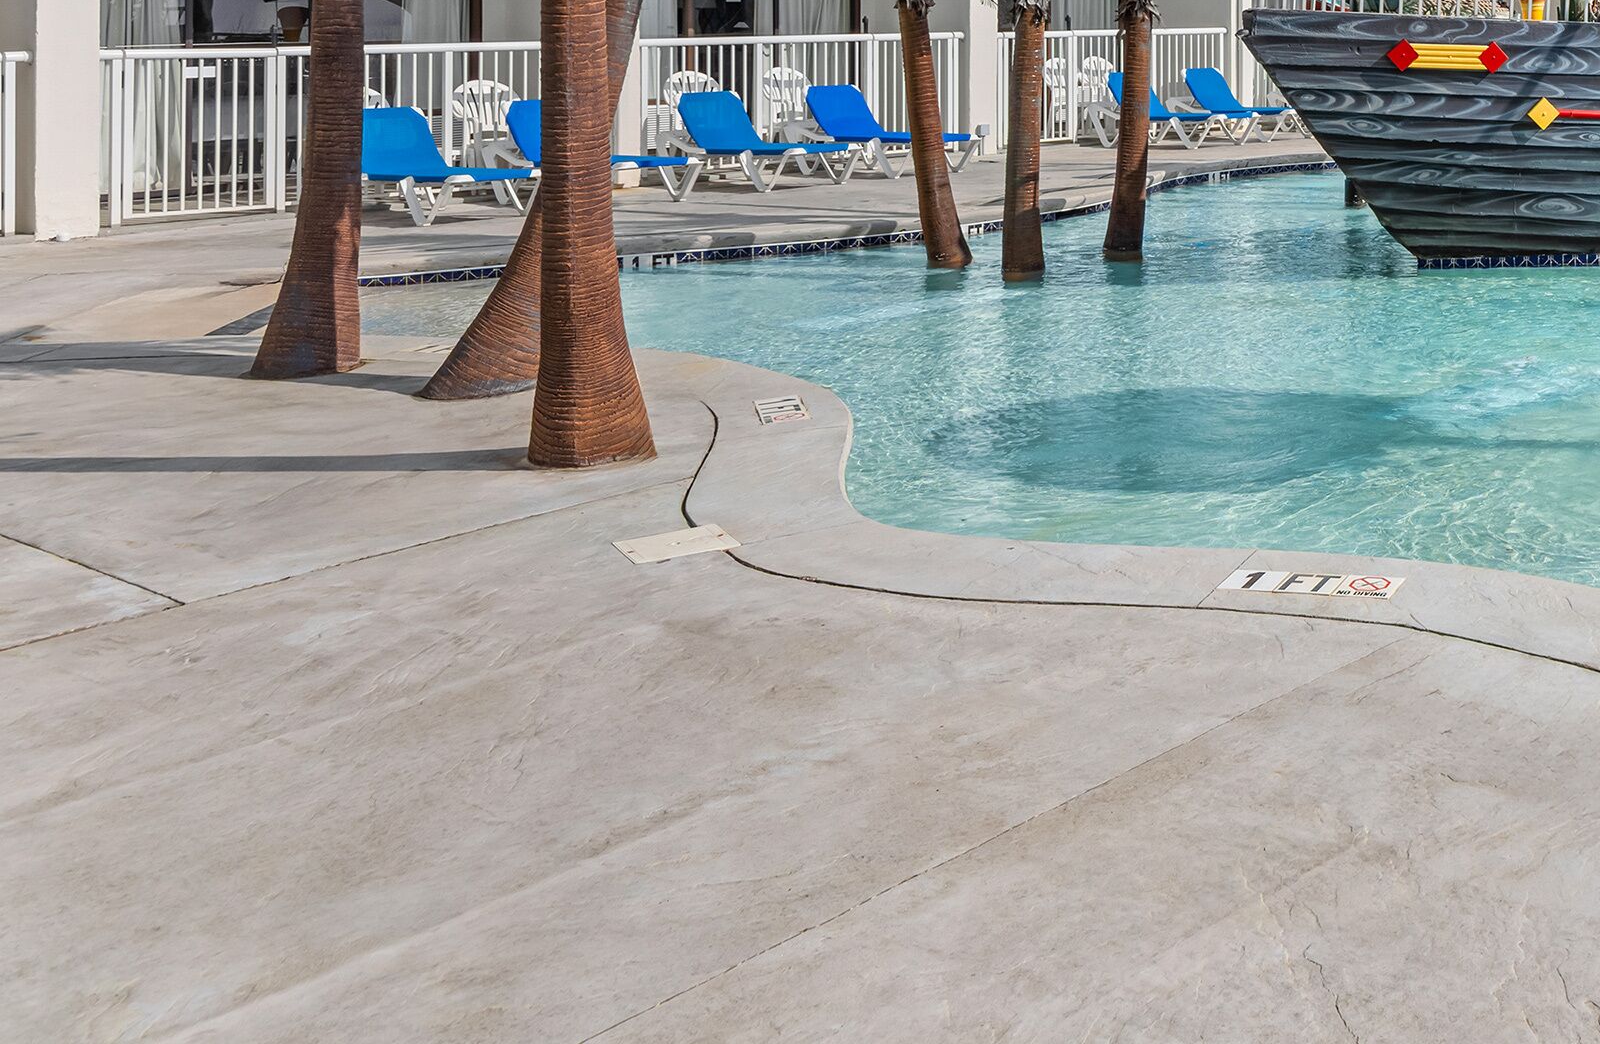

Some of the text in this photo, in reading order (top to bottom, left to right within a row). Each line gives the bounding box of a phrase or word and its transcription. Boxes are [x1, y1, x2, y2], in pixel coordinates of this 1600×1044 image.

[967, 224, 982, 235] FT
[632, 252, 675, 269] 1 FT
[1241, 571, 1342, 593] 1 FT
